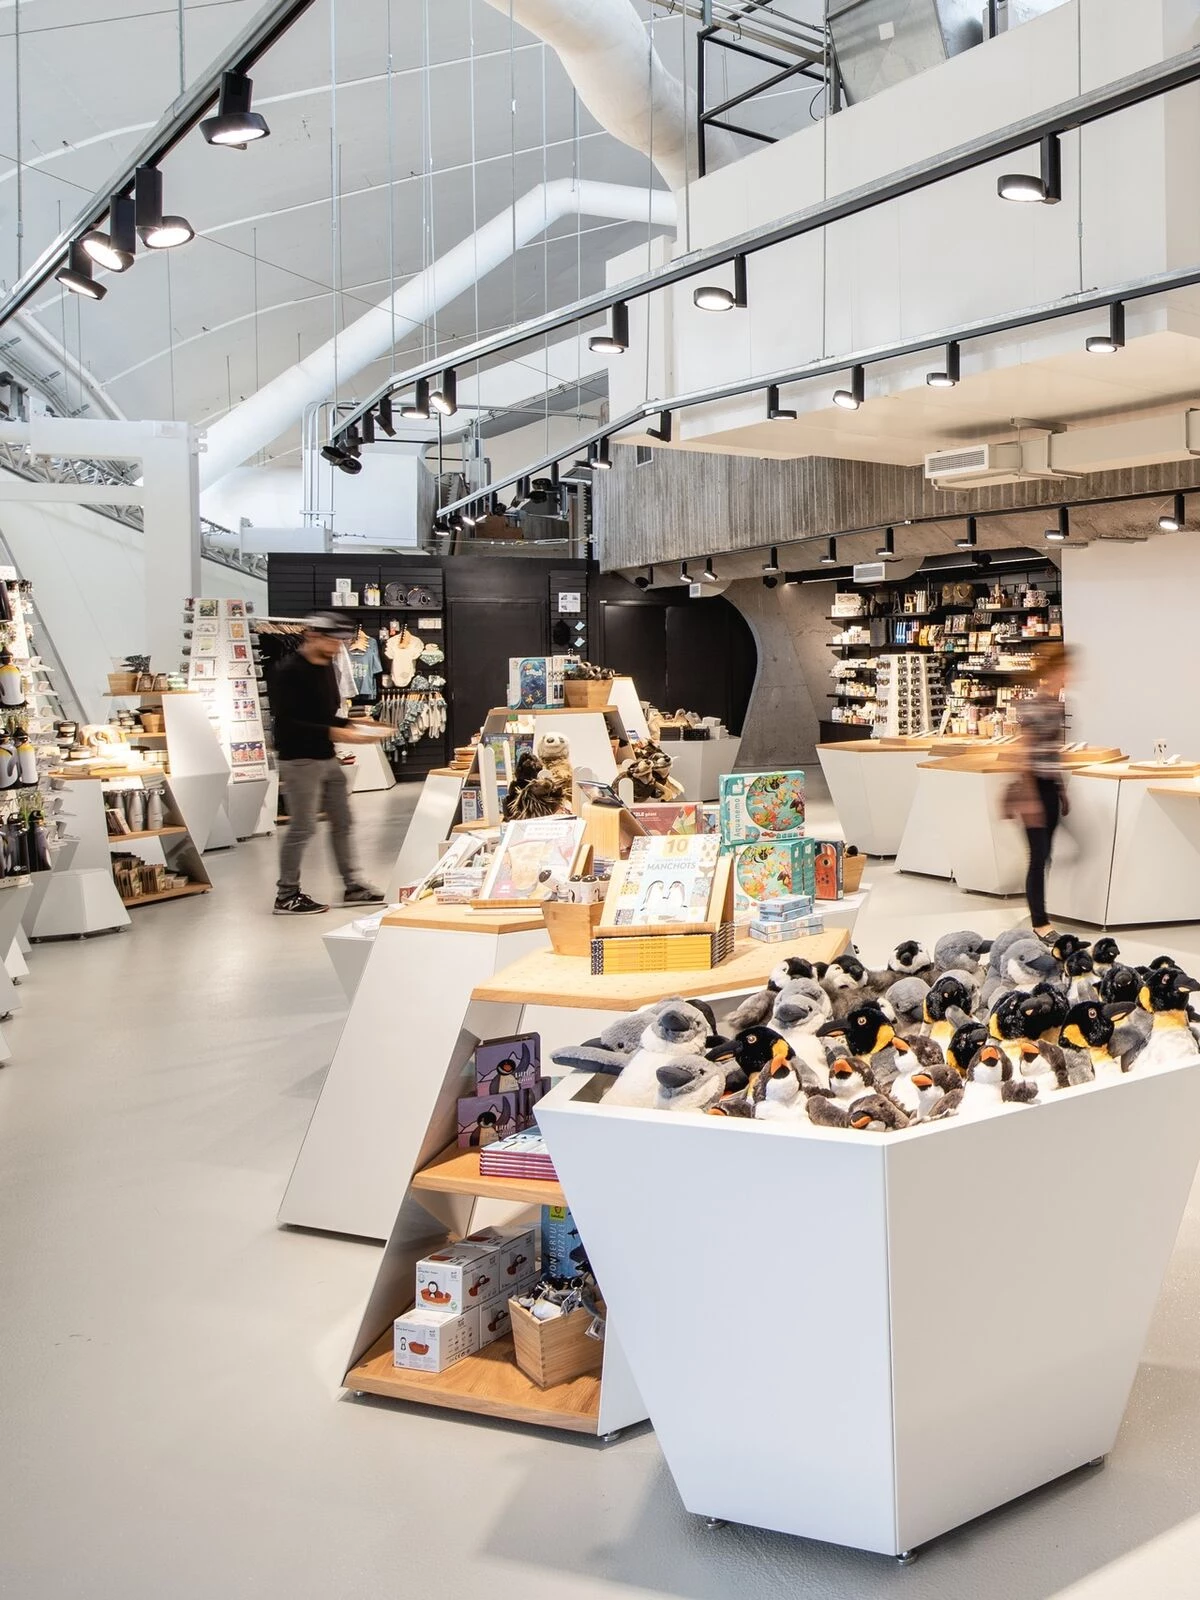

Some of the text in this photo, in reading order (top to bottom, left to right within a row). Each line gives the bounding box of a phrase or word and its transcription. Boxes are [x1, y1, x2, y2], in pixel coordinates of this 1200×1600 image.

[733, 798, 742, 837] Aquanemo
[666, 839, 689, 854] 10
[647, 862, 696, 871] MANCHOTS
[557, 1223, 566, 1258] PUZZLE
